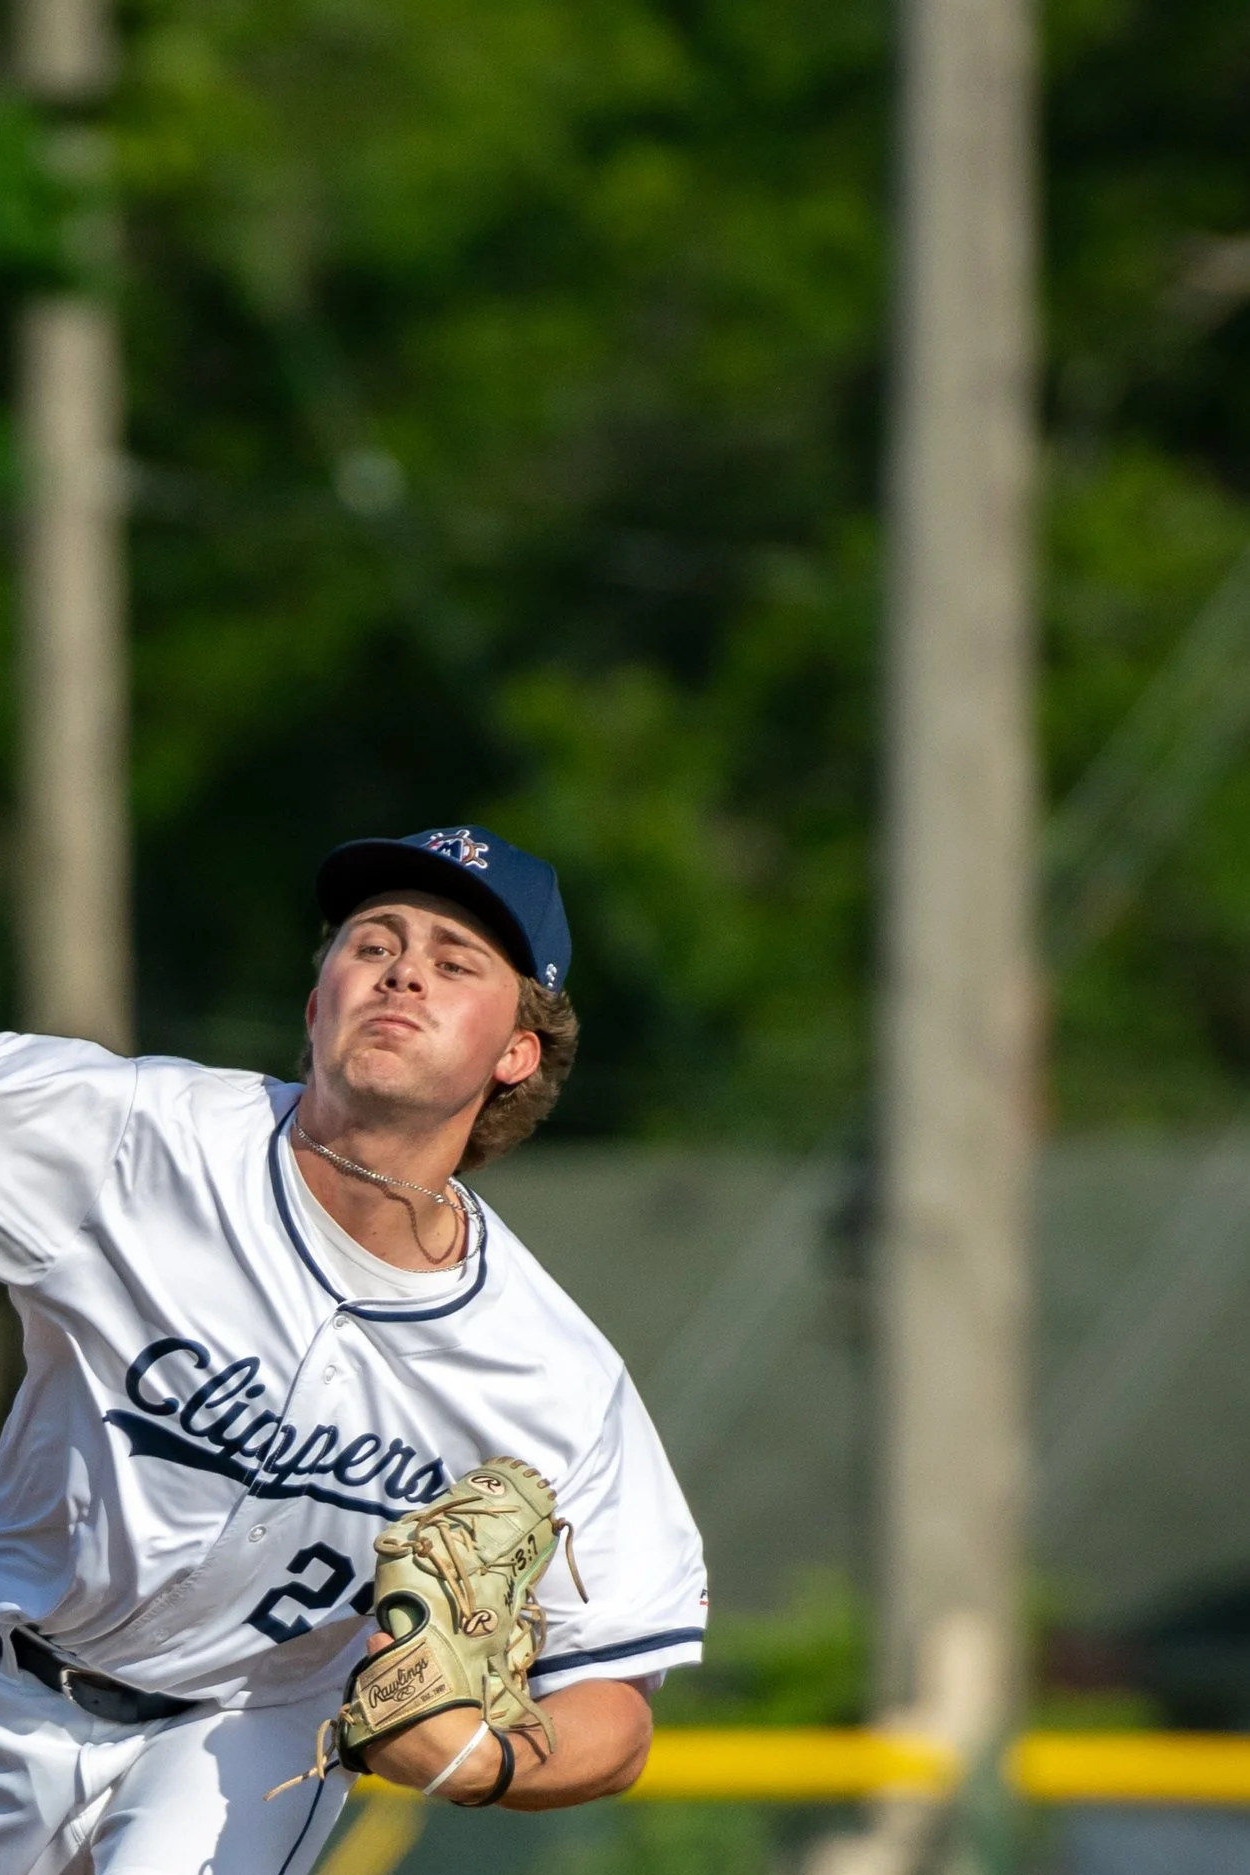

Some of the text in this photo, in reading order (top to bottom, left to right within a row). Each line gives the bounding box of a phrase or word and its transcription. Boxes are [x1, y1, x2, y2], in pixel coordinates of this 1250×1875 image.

[125, 1337, 451, 1504] Clippers
[242, 1541, 376, 1645] 2
[368, 1657, 429, 1709] Rawlings
